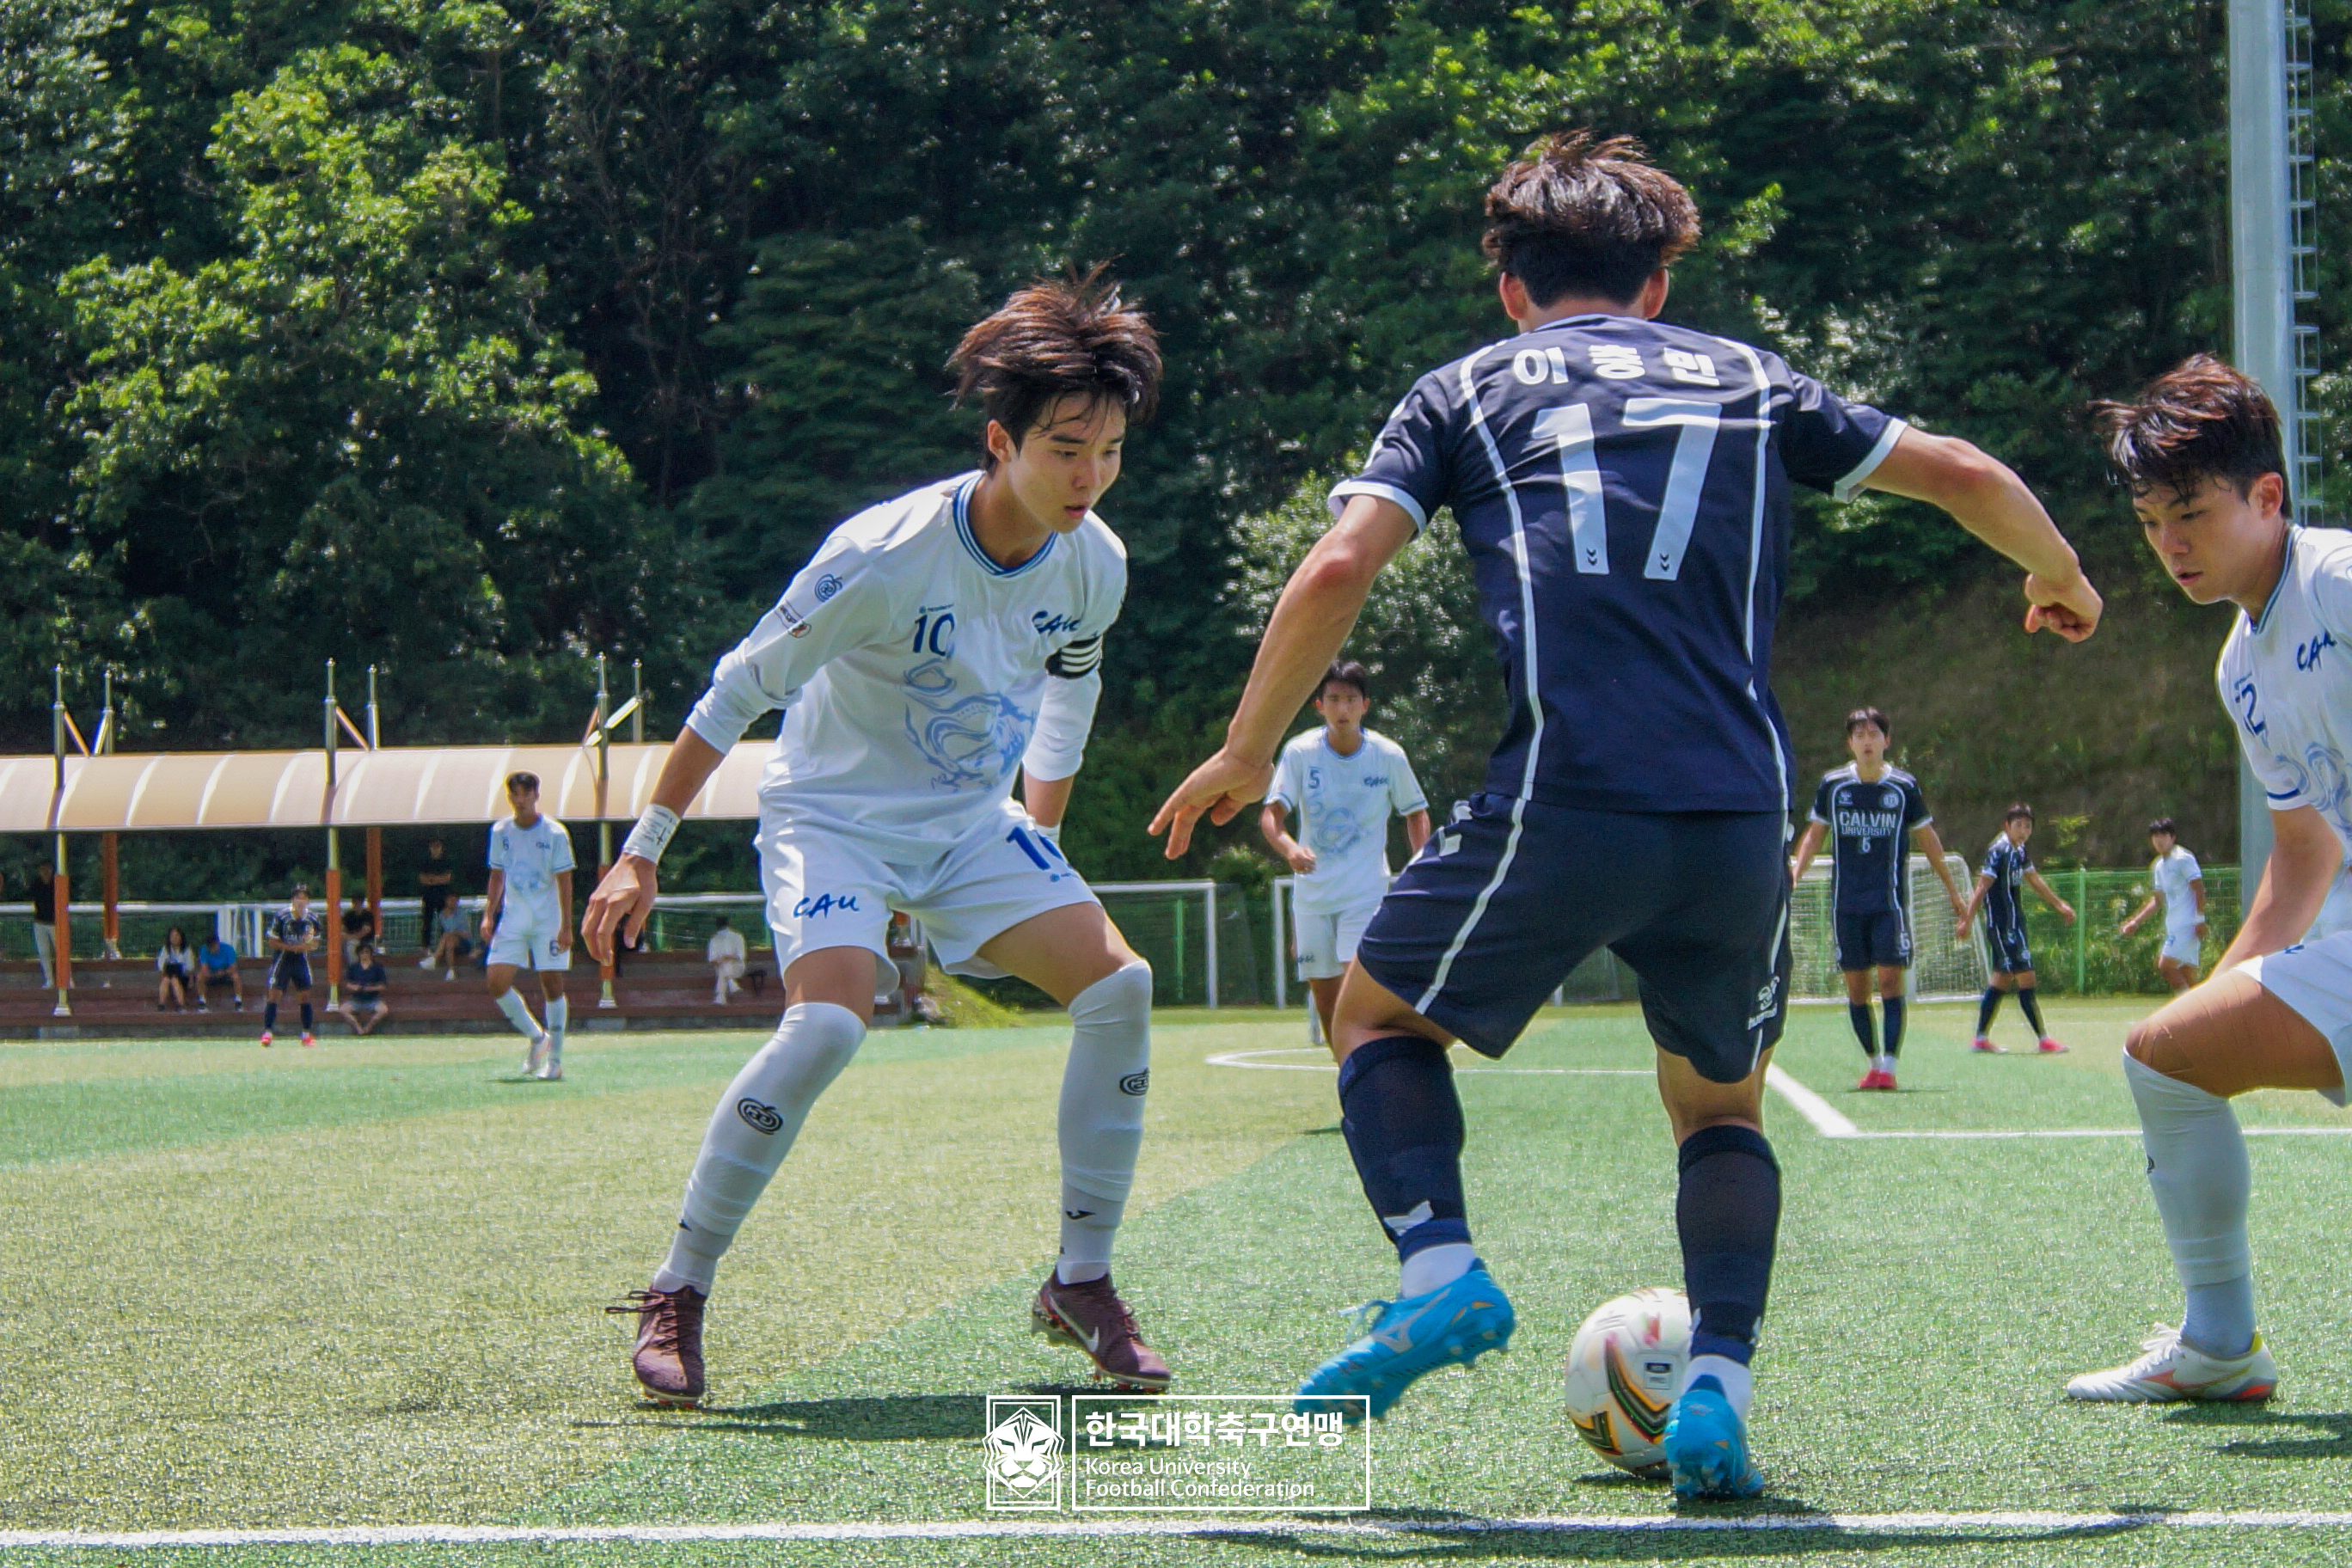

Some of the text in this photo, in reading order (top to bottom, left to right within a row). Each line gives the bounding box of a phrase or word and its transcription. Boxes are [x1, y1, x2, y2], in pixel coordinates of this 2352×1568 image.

[1532, 398, 1722, 580] 17
[912, 612, 955, 657] 10
[1308, 769, 1320, 789] 5
[1839, 811, 1896, 829] CALVIN
[1841, 826, 1892, 836] UNIVERSITY
[502, 836, 510, 851] 6
